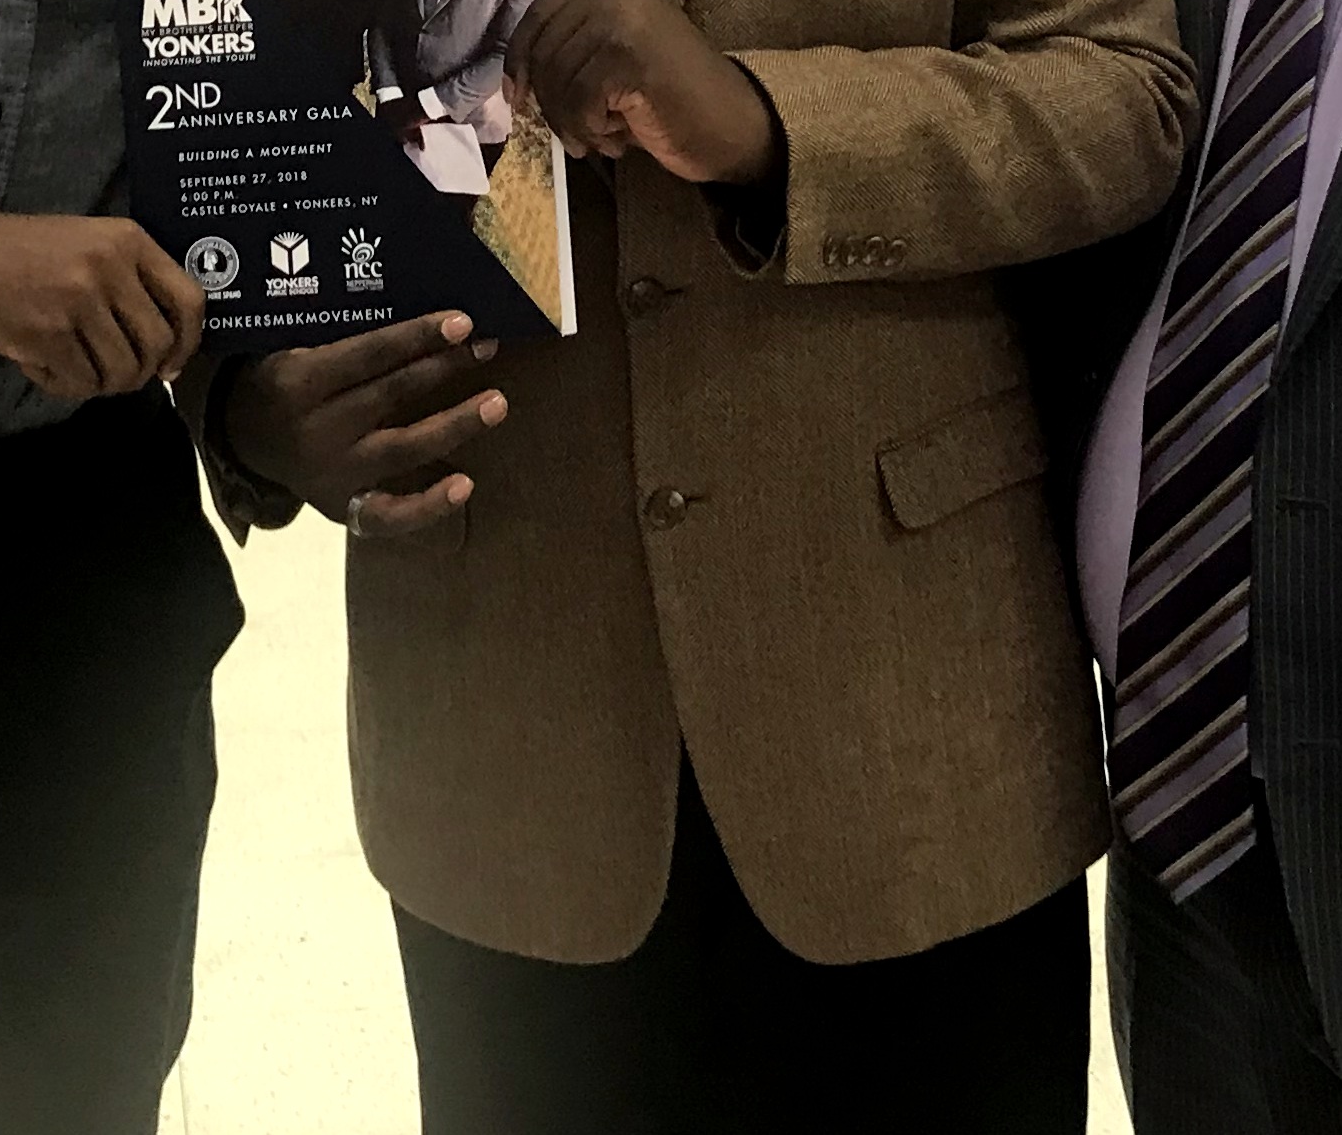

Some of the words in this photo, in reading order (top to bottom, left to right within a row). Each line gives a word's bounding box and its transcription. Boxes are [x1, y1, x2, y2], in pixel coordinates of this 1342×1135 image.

[141, 28, 156, 37] MY
[160, 25, 214, 36] BROTHER'S
[218, 23, 254, 32] KEEPER
[142, 32, 255, 59] YONKERS
[143, 57, 202, 67] INNOVATING
[206, 55, 222, 64] THE
[226, 54, 257, 62] YOUTH
[178, 109, 298, 129] ANNIVERSARY
[307, 106, 353, 121] GALA
[178, 149, 240, 162] BUILDING
[246, 148, 254, 159] A
[260, 143, 333, 158] MOVEMENT
[180, 175, 247, 189] SEPTEMBER
[253, 173, 272, 185] 27,
[277, 171, 308, 183] 2018
[182, 205, 225, 217] CASTLE
[231, 202, 277, 214] ROYALE
[294, 197, 357, 210] YONKERS,
[362, 196, 379, 206] NY
[344, 261, 383, 279] ncc
[265, 276, 319, 290] YONKERS
